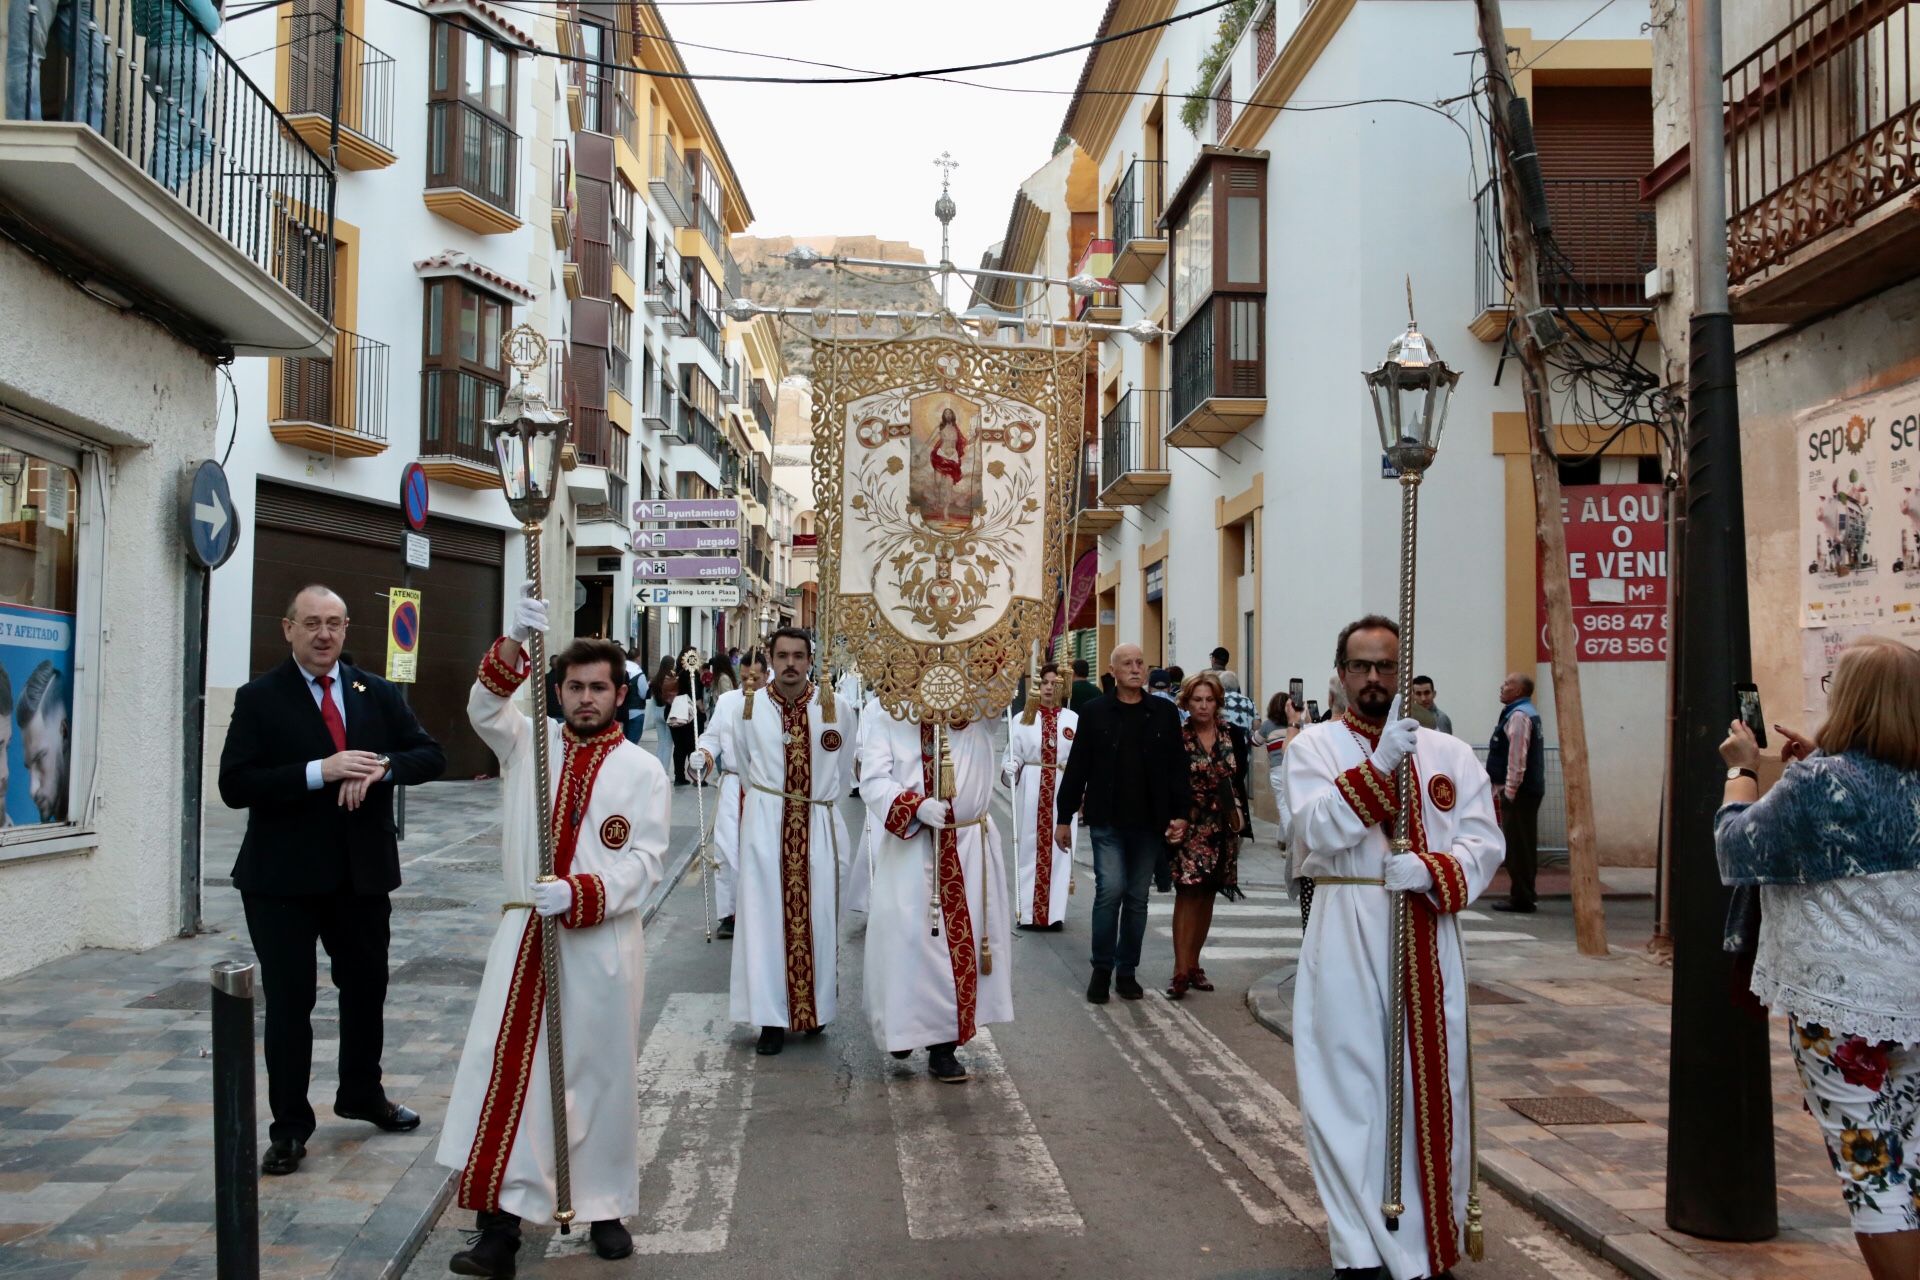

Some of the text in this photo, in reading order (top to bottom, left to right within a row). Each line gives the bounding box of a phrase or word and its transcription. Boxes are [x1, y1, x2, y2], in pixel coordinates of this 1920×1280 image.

[1809, 416, 1876, 464] sepor
[1890, 414, 1920, 451] se
[667, 508, 736, 519] ayuntamiento
[1580, 495, 1659, 523] ALQU
[696, 537, 736, 548] juzgado
[1612, 525, 1633, 548] O
[700, 566, 737, 575] castillo
[1569, 552, 1586, 579] E
[1583, 614, 1625, 631] 968
[1629, 613, 1655, 630] 47
[6, 623, 13, 636] Y
[15, 625, 59, 642] AFEITADO
[1584, 637, 1623, 655] 678
[1627, 637, 1654, 654] 56
